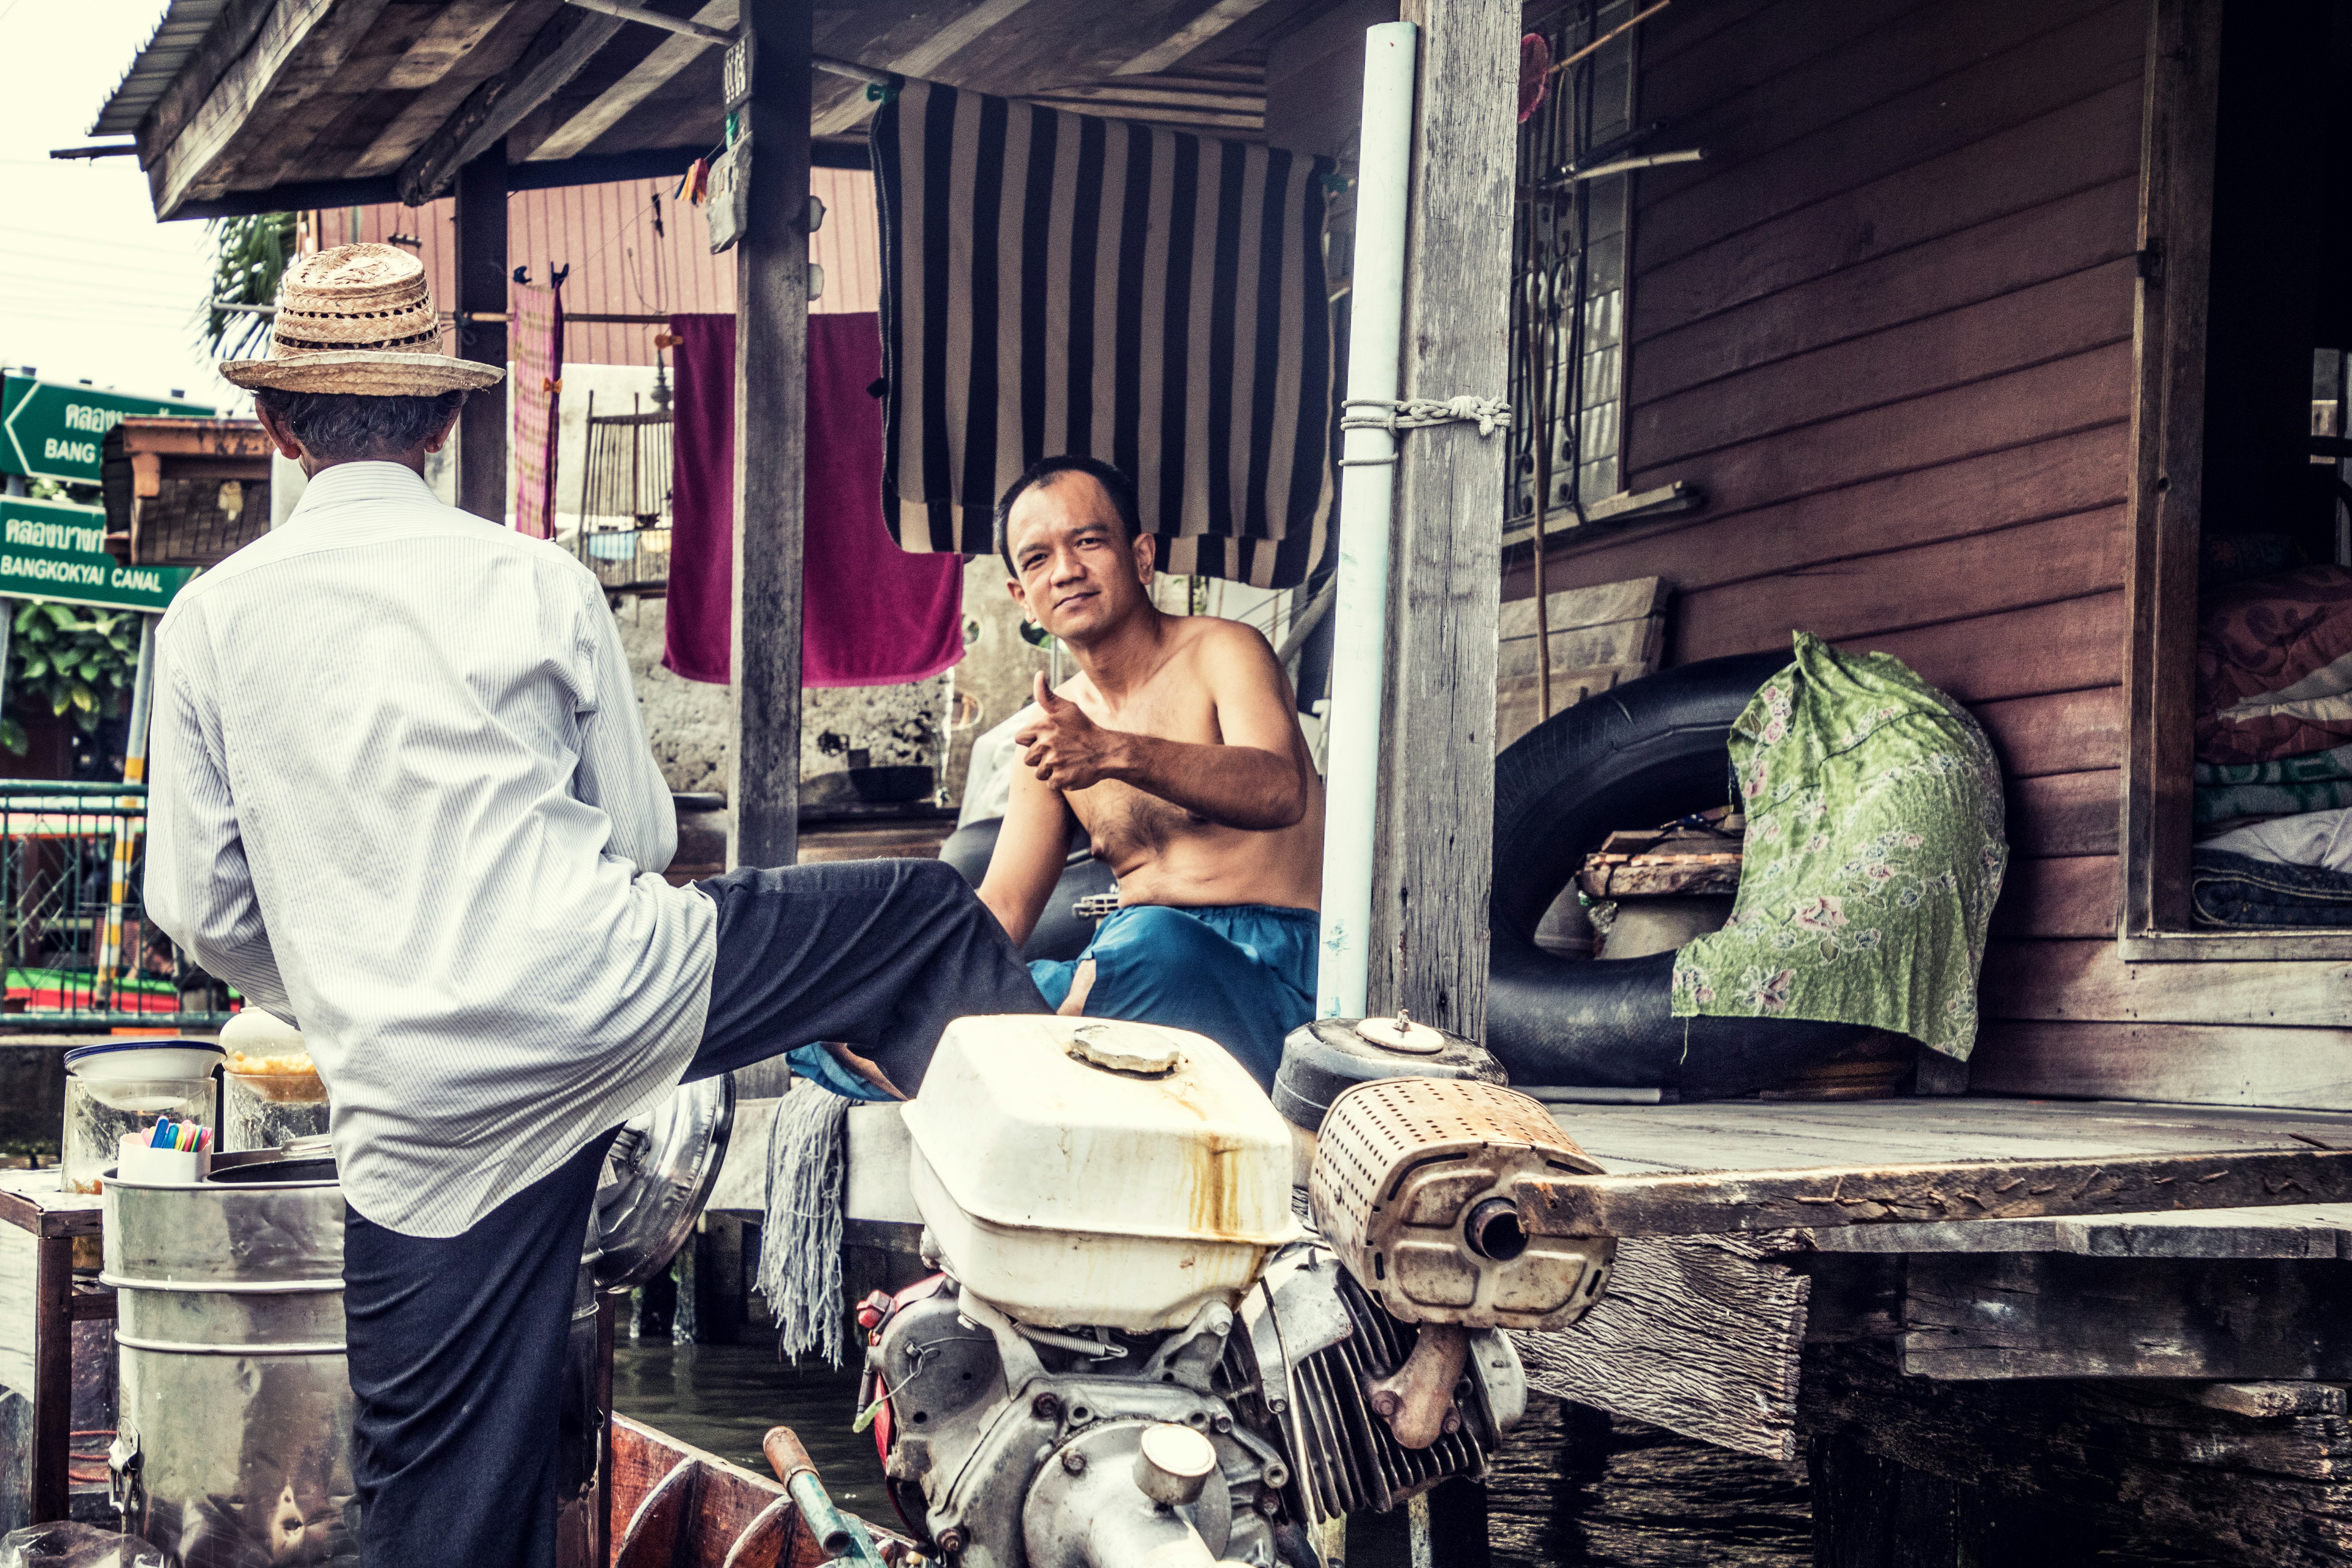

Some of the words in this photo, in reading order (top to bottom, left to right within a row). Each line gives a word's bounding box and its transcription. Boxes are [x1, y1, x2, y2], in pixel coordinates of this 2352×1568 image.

[44, 438, 96, 463] BANG
[0, 555, 105, 586] BANGKOKYAI
[111, 568, 163, 593] CANAL
